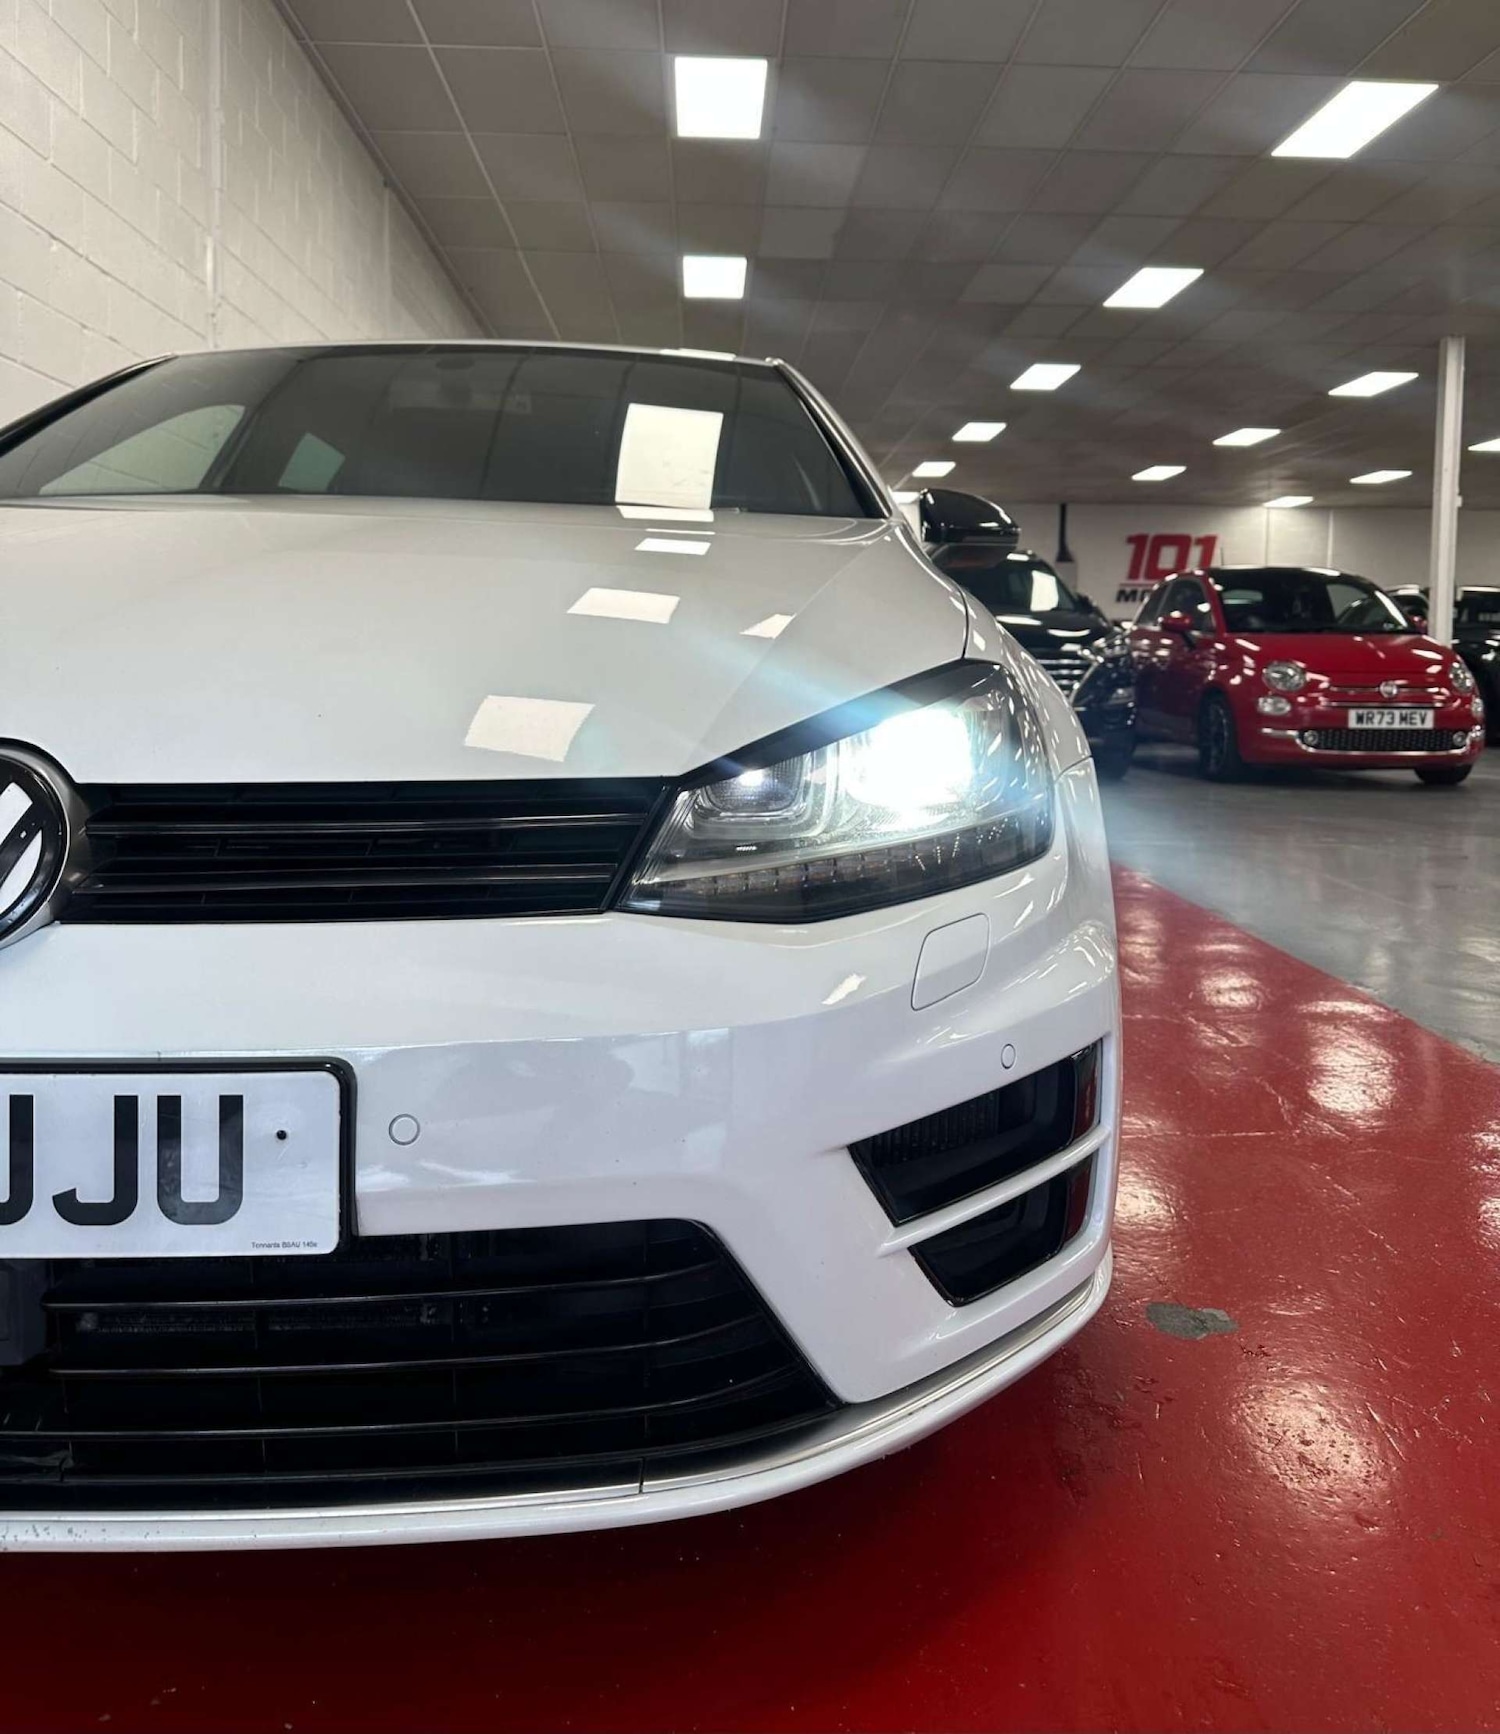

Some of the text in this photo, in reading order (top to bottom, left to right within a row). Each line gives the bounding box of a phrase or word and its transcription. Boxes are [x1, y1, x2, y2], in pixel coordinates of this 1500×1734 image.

[1126, 533, 1217, 581] 101
[1355, 710, 1427, 726] WR73 MEV
